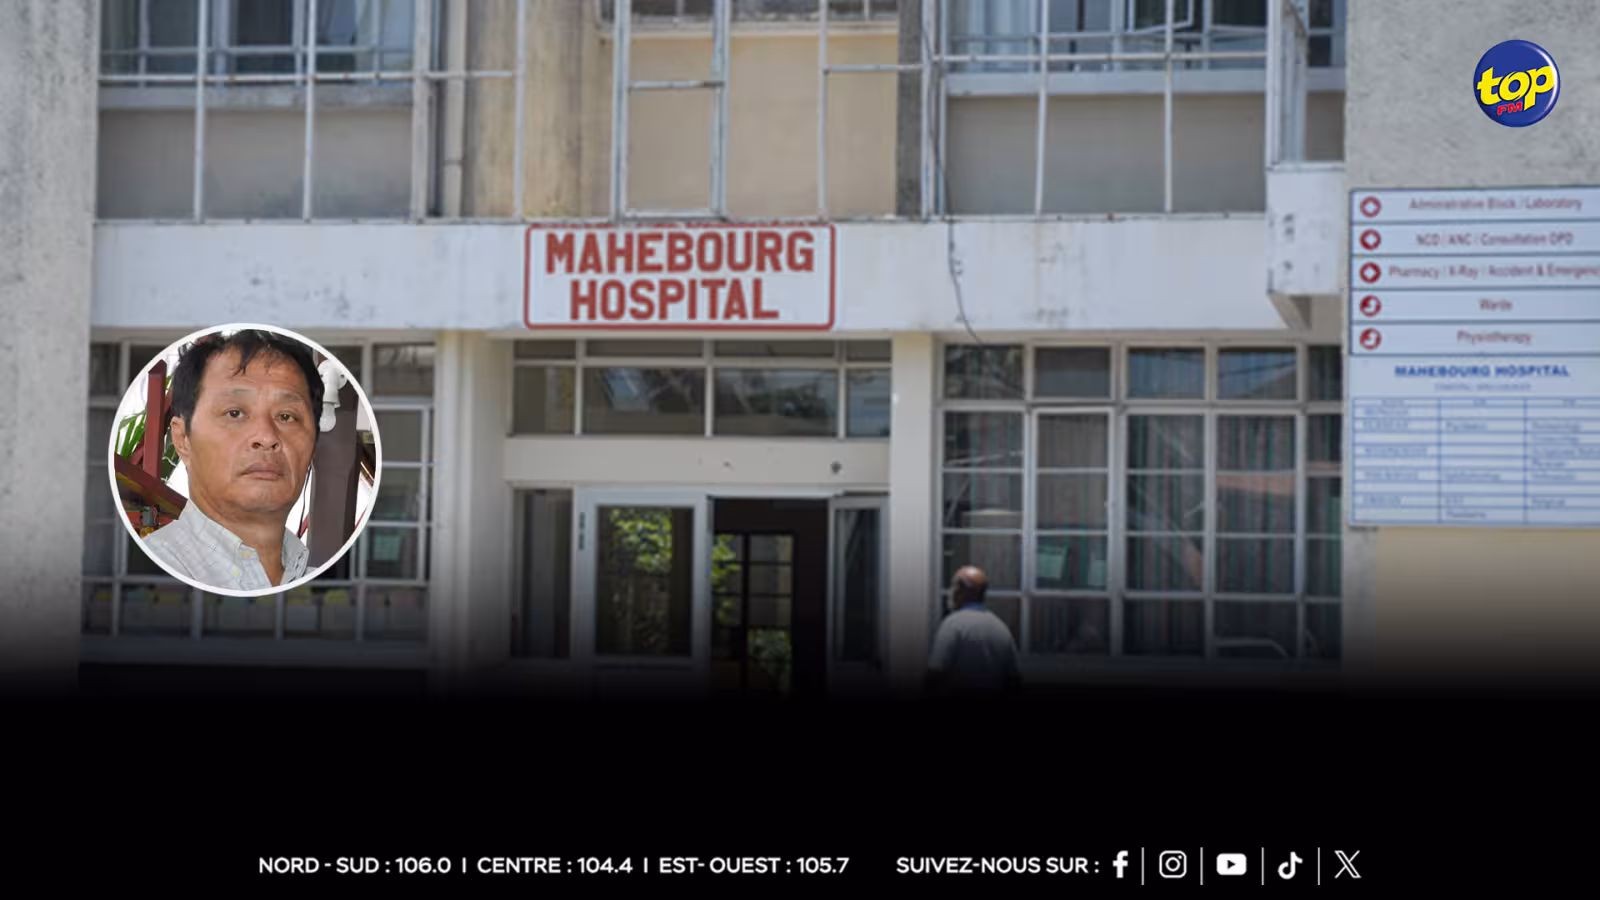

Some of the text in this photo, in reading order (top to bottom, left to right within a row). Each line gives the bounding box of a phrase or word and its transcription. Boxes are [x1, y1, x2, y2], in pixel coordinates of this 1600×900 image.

[1487, 197, 1516, 209] Block
[1525, 197, 1583, 211] Laboratory
[1480, 232, 1547, 245] Consultation
[545, 231, 814, 274] MAHEBOURG
[1388, 266, 1440, 280] Pharmacy
[1449, 266, 1479, 280] X-Ray
[1489, 265, 1533, 277] Accident
[1536, 264, 1544, 276] &
[570, 278, 780, 321] HOSPITAL
[1456, 330, 1532, 345] Physiotherapy
[1394, 365, 1570, 378] MAHEBOURG HOSPITAL
